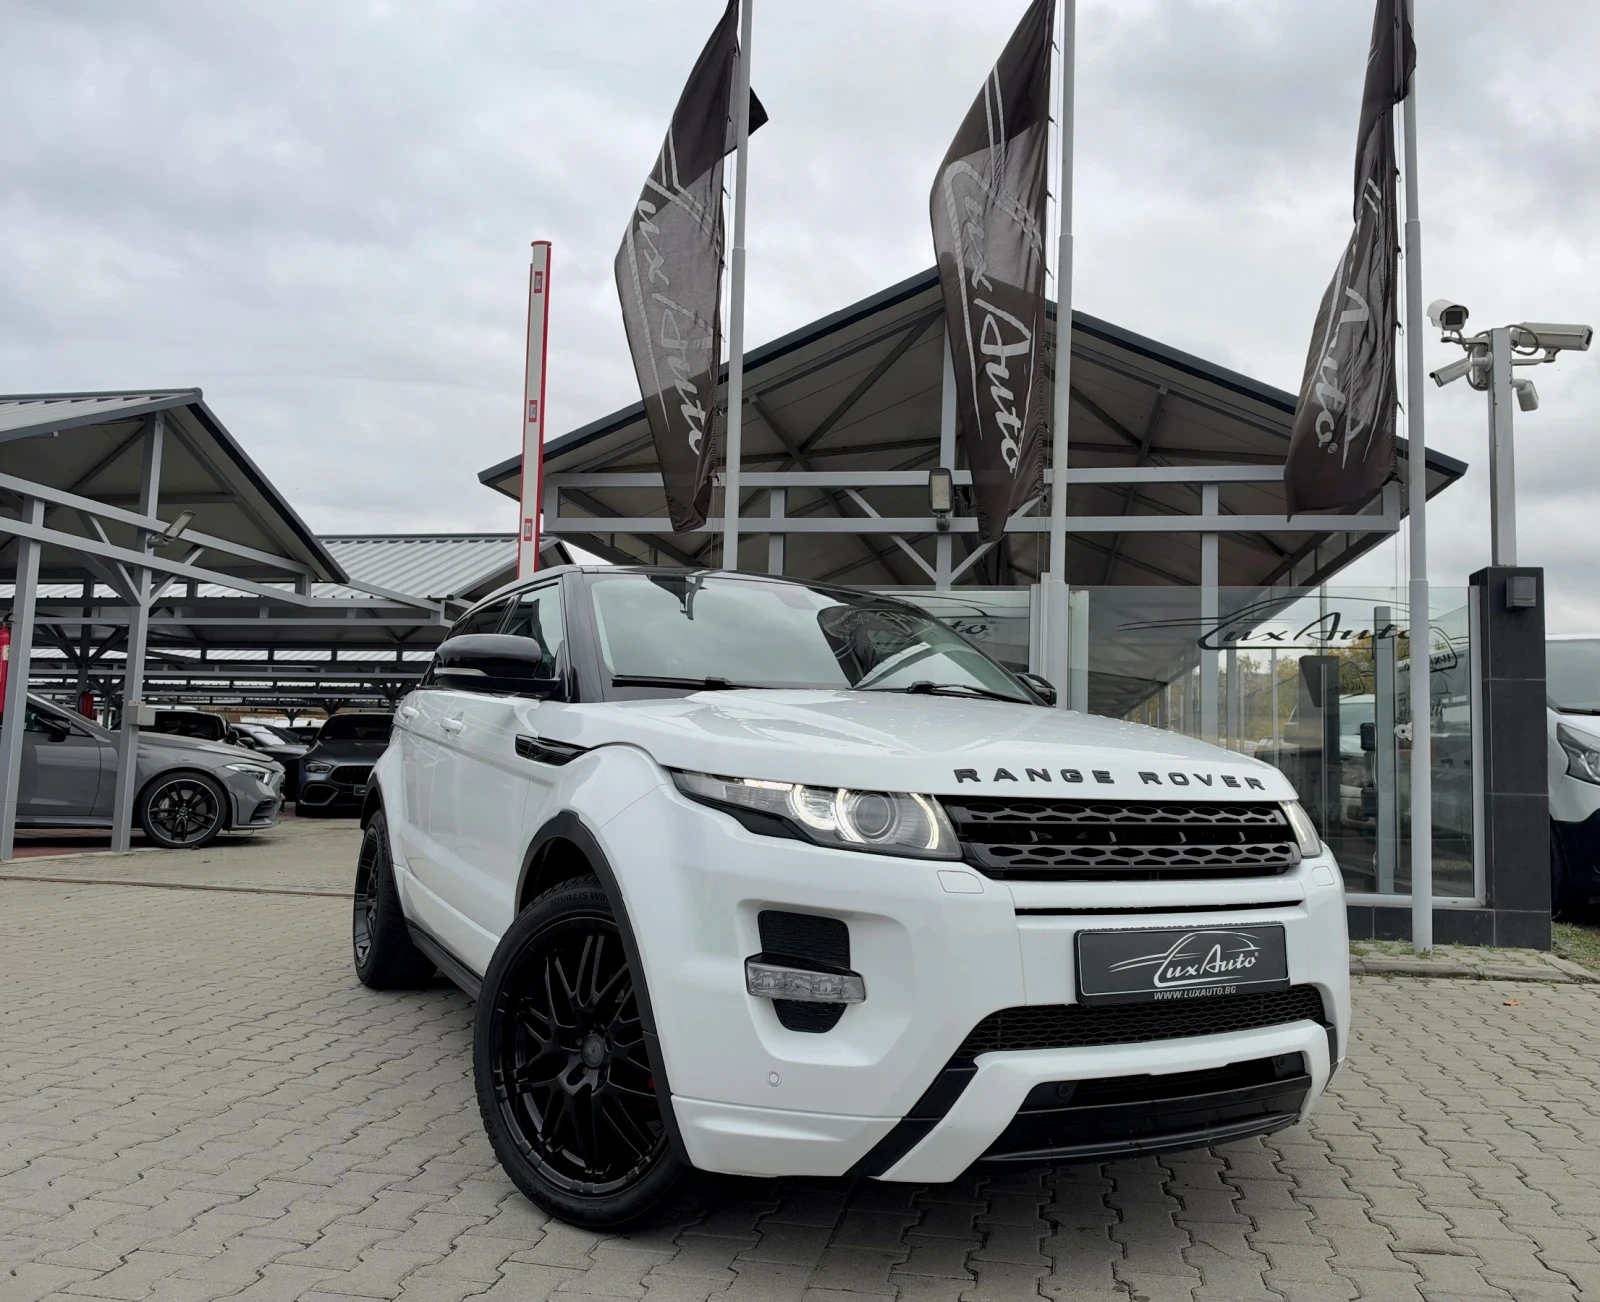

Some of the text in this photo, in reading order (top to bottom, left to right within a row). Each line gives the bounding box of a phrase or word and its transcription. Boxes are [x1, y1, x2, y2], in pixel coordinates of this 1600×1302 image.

[952, 767, 1266, 791] RANGE ROVER
[550, 891, 588, 905] NIVALIS
[1153, 985, 1237, 1001] WWW.LUXAUTO.BG
